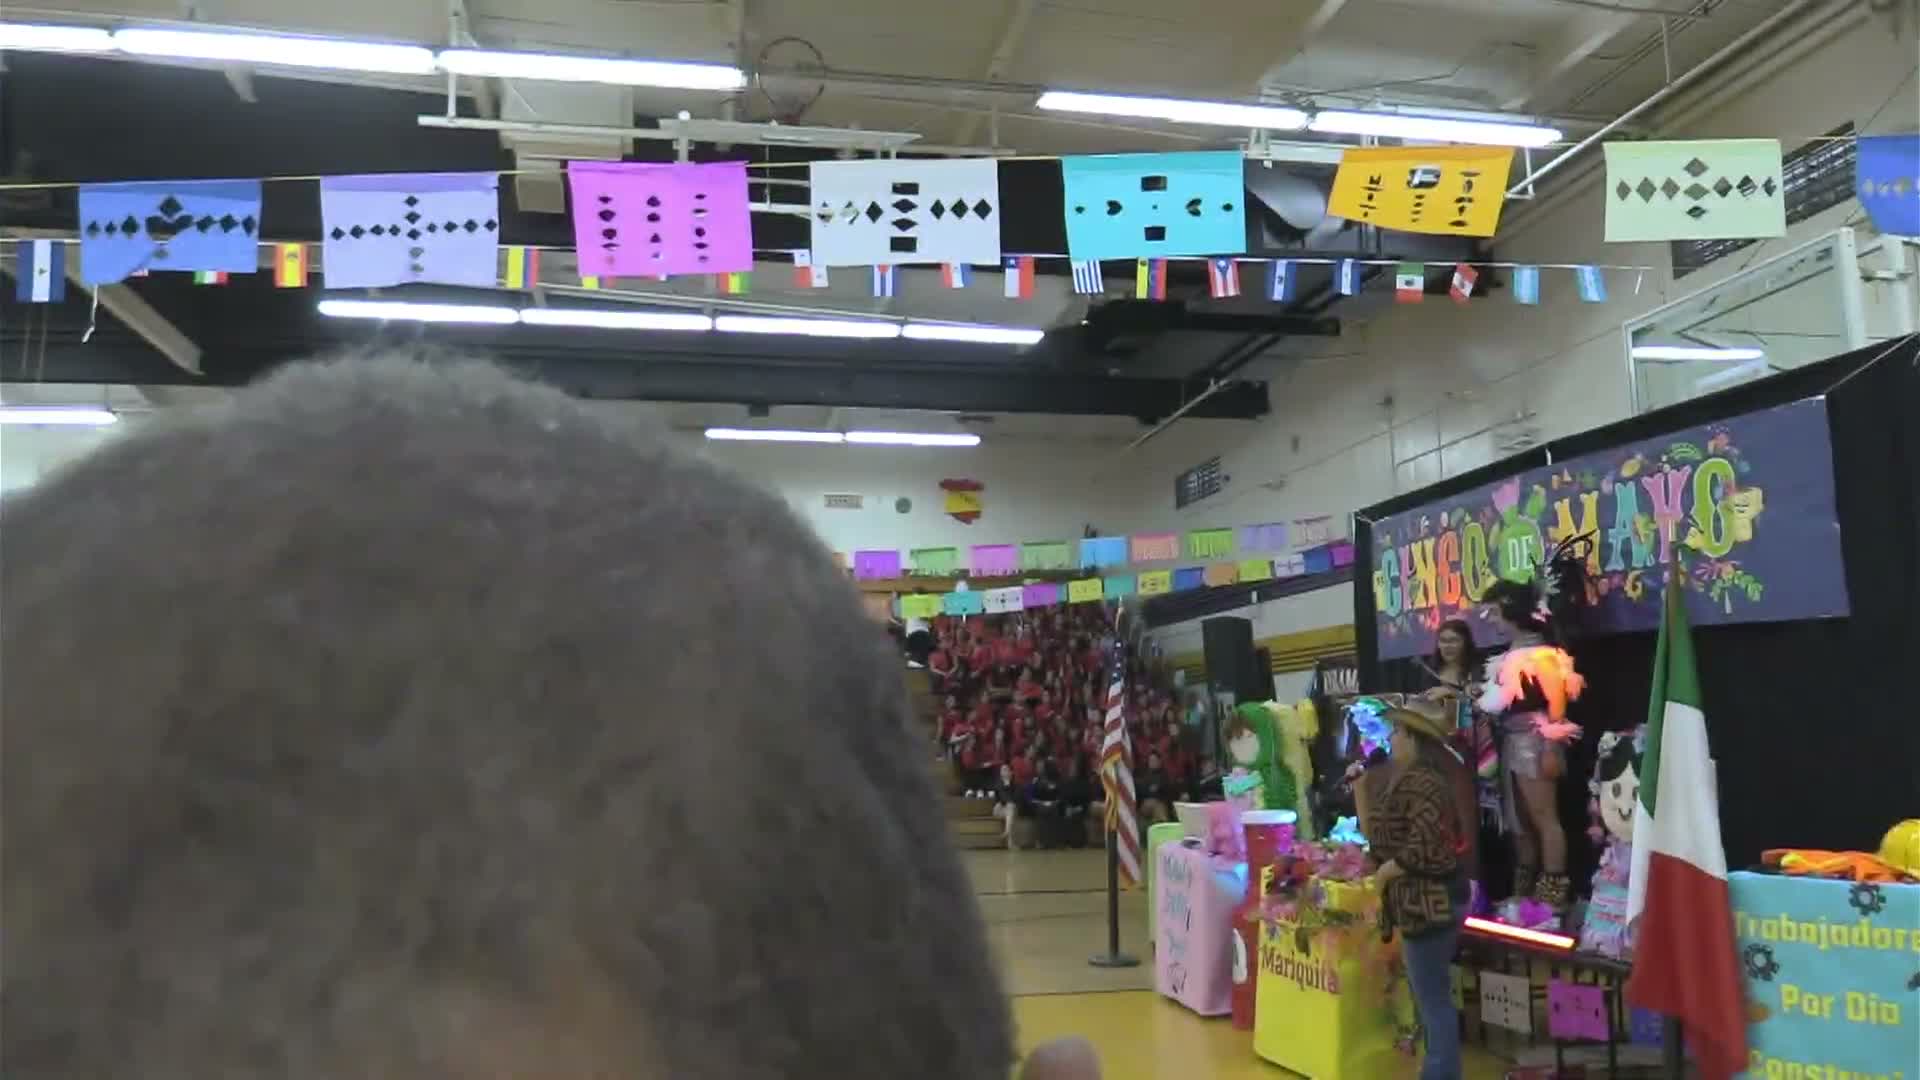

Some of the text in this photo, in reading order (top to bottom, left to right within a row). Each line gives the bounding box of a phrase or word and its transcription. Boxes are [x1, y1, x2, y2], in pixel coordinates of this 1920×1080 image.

[1382, 459, 1735, 617] CINCO DE MAYO
[1261, 945, 1339, 995] Mariquita
[1780, 983, 1835, 1019] Por
